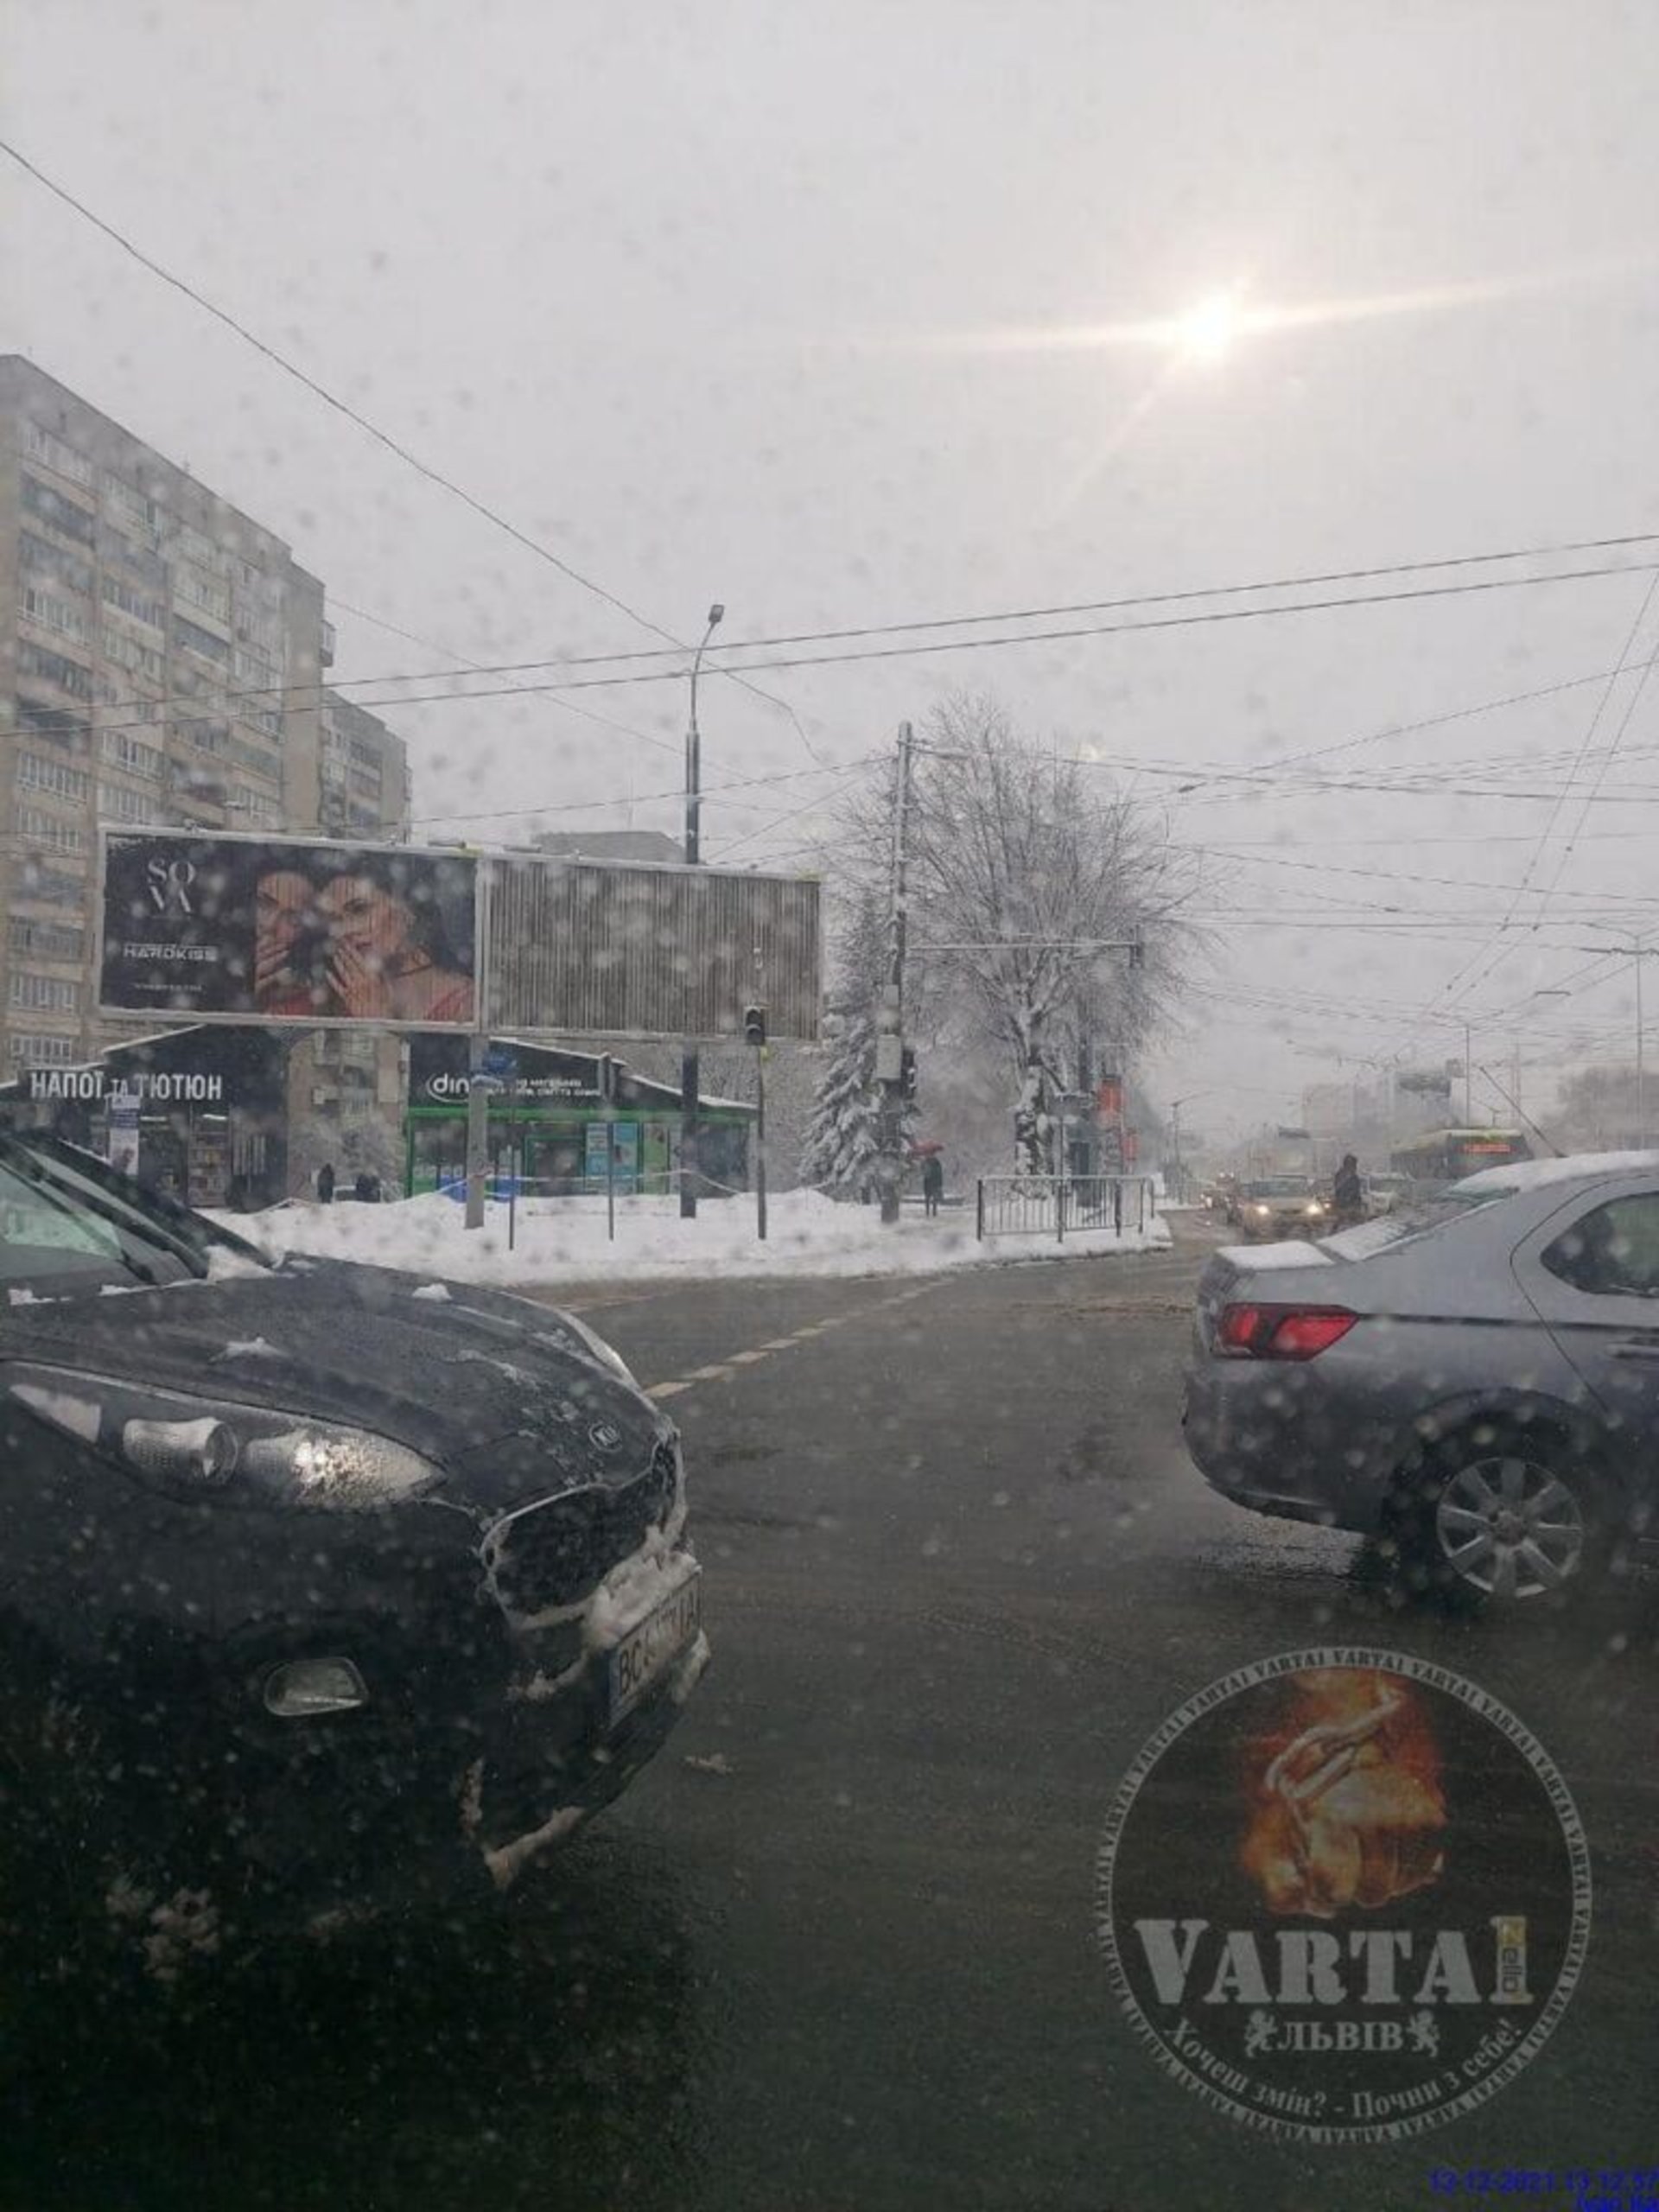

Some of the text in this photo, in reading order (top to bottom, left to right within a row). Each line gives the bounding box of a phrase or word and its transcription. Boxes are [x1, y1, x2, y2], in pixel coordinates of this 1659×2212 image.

[31, 1071, 104, 1098] НАПОЇ
[134, 1073, 222, 1100] ТЮТЮН
[433, 1072, 470, 1094] din
